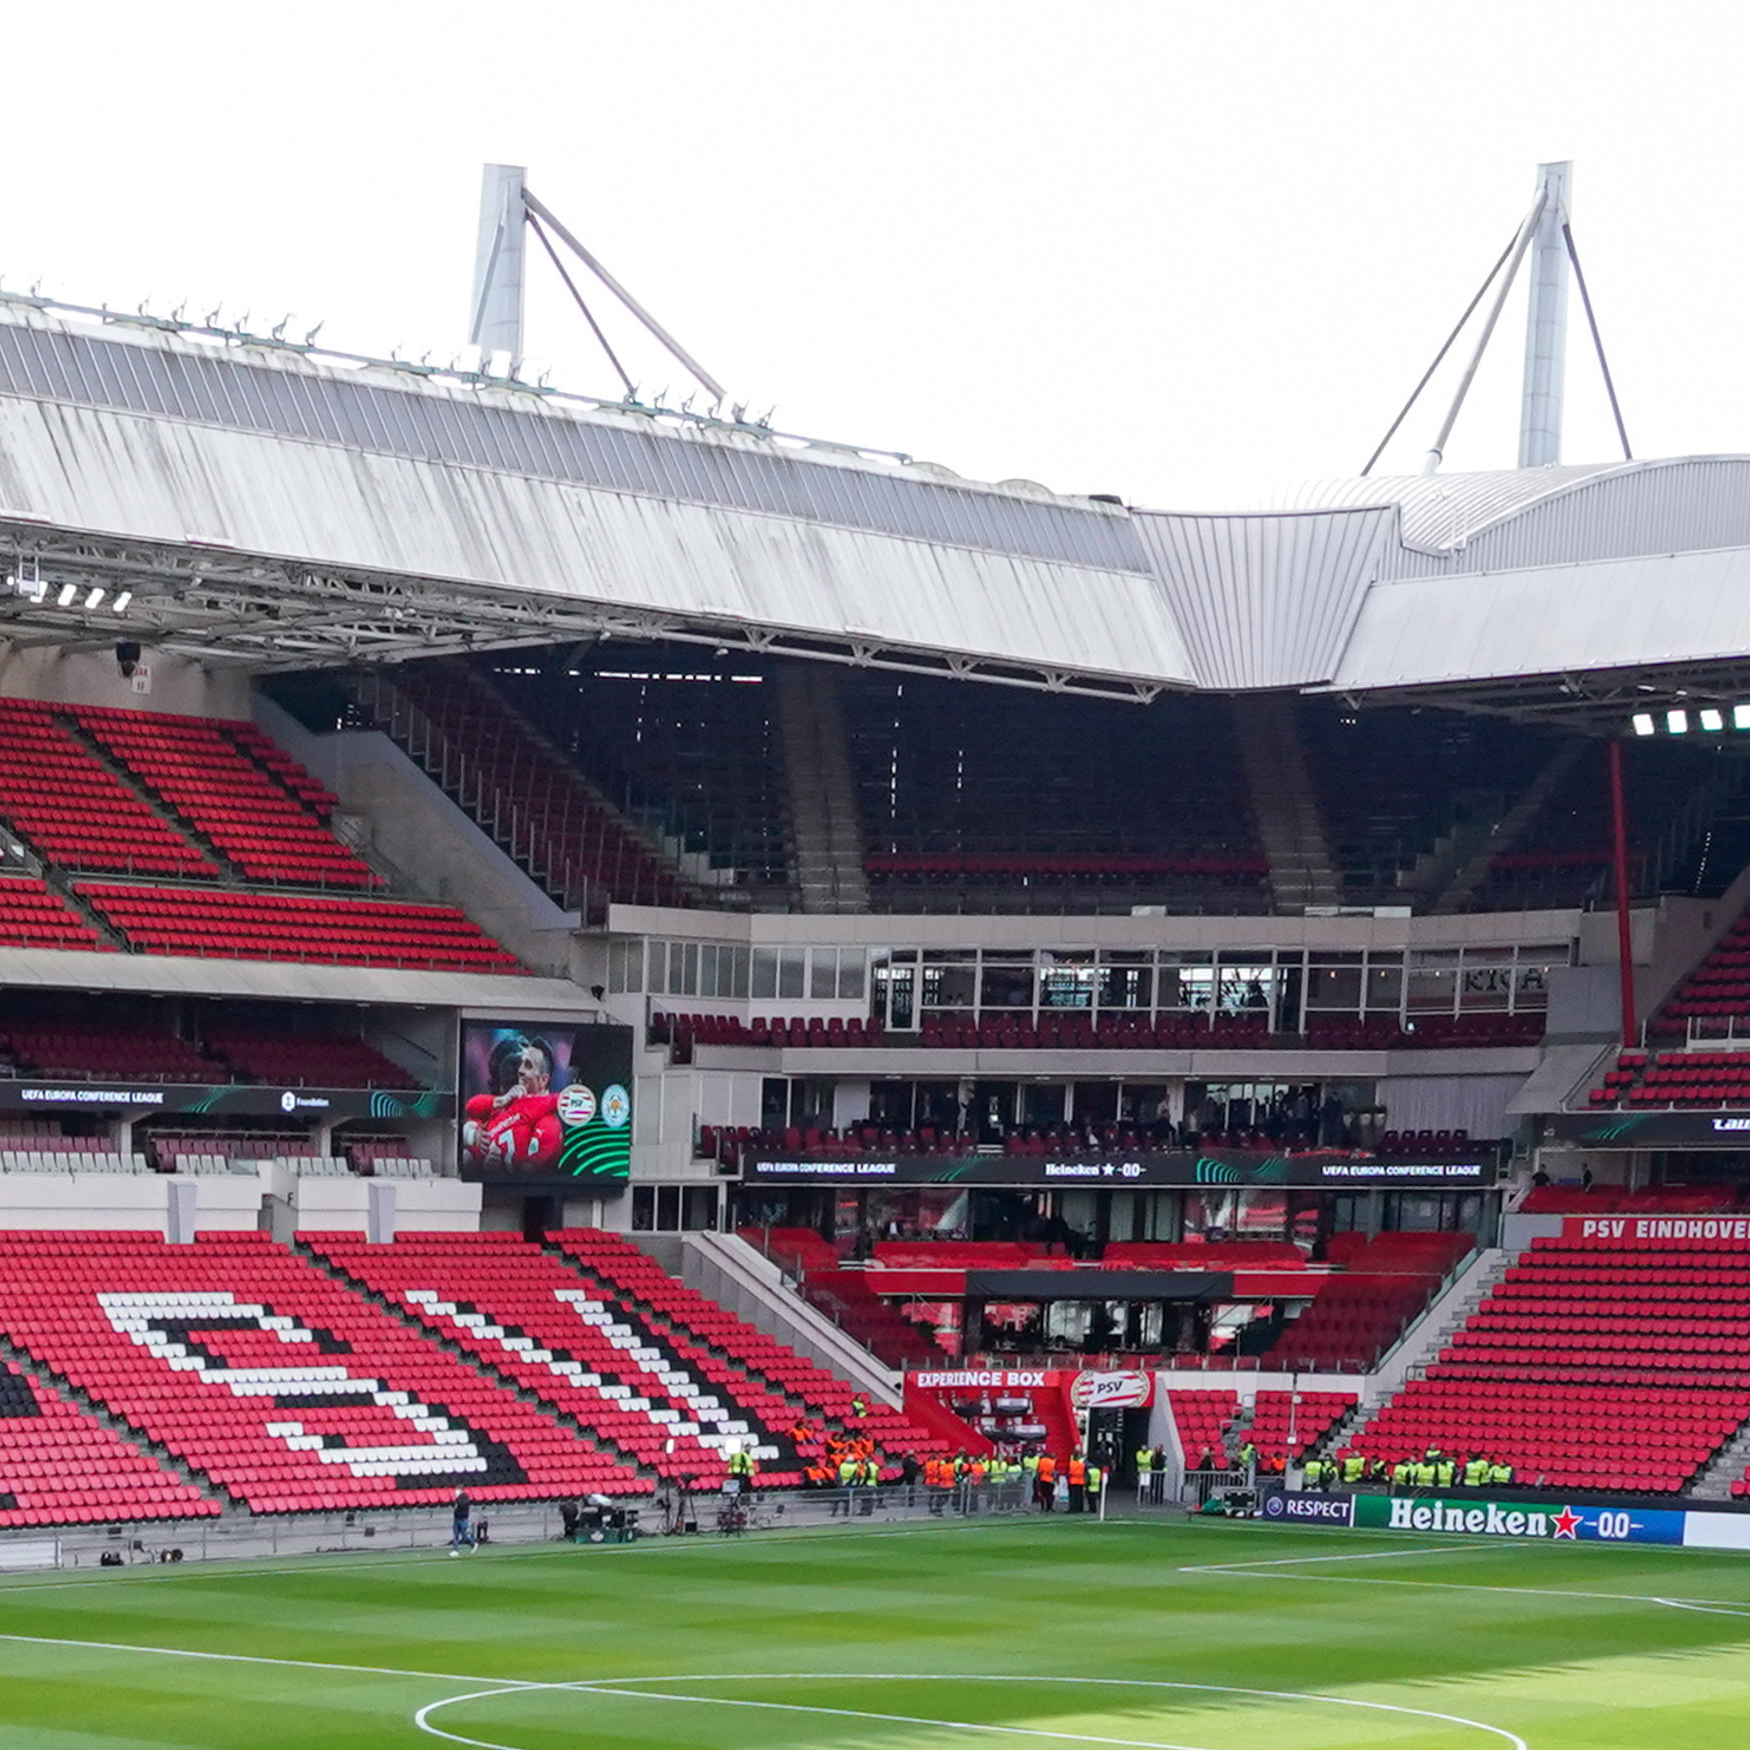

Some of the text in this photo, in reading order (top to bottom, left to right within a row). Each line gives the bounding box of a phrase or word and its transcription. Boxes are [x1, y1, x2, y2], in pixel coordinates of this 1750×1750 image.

[1322, 1165, 1481, 1176] UEFA EUROPA CONFERENCE LEAGUE
[1583, 1220, 1625, 1238] PSV
[917, 1371, 1046, 1388] EXPERIENCE BOX
[1097, 1381, 1123, 1395] PSV
[1286, 1500, 1349, 1520] RESPECT
[1389, 1499, 1547, 1537] Heineken
